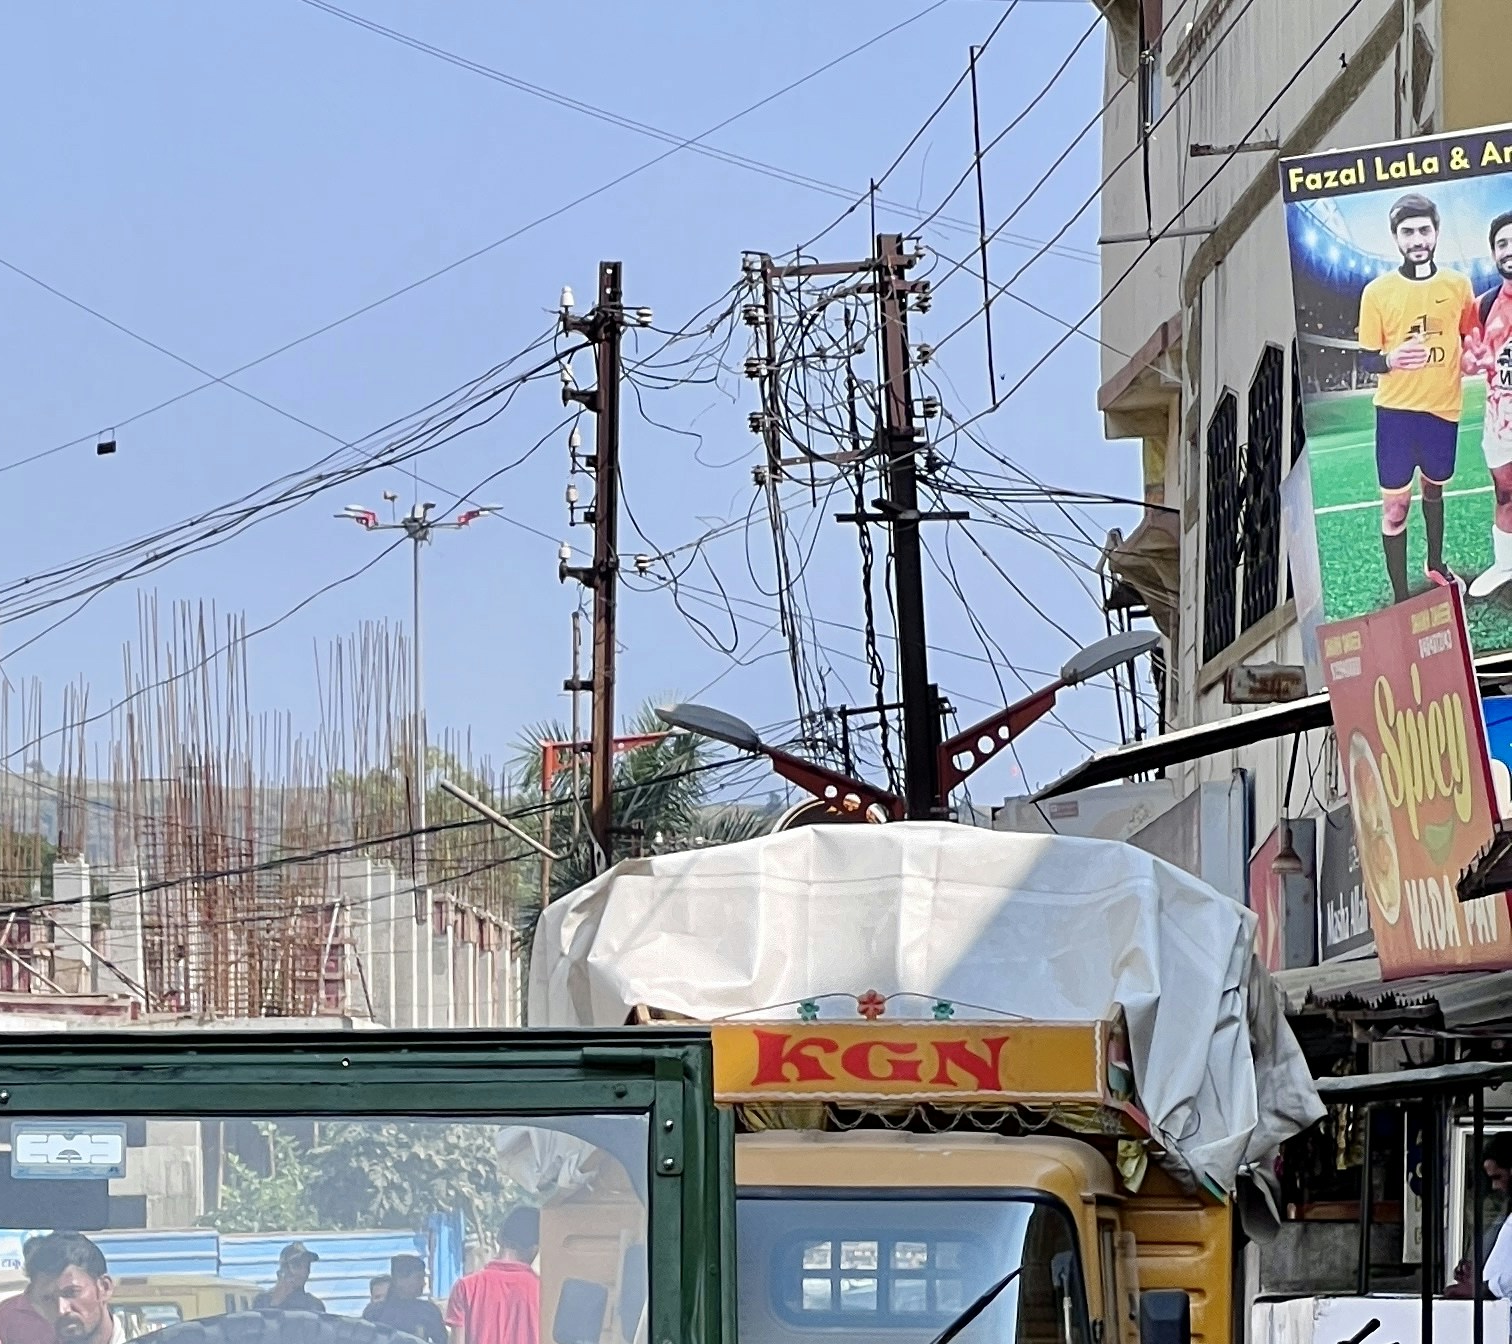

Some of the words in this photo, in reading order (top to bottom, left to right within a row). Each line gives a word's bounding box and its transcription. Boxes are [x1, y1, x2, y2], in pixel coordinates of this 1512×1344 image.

[1288, 158, 1365, 193] Fazal
[1374, 152, 1439, 182] LaLa
[1449, 146, 1470, 171] &
[1374, 662, 1472, 841] Spicy
[1404, 874, 1462, 951] VADA
[750, 1029, 1010, 1092] KGN
